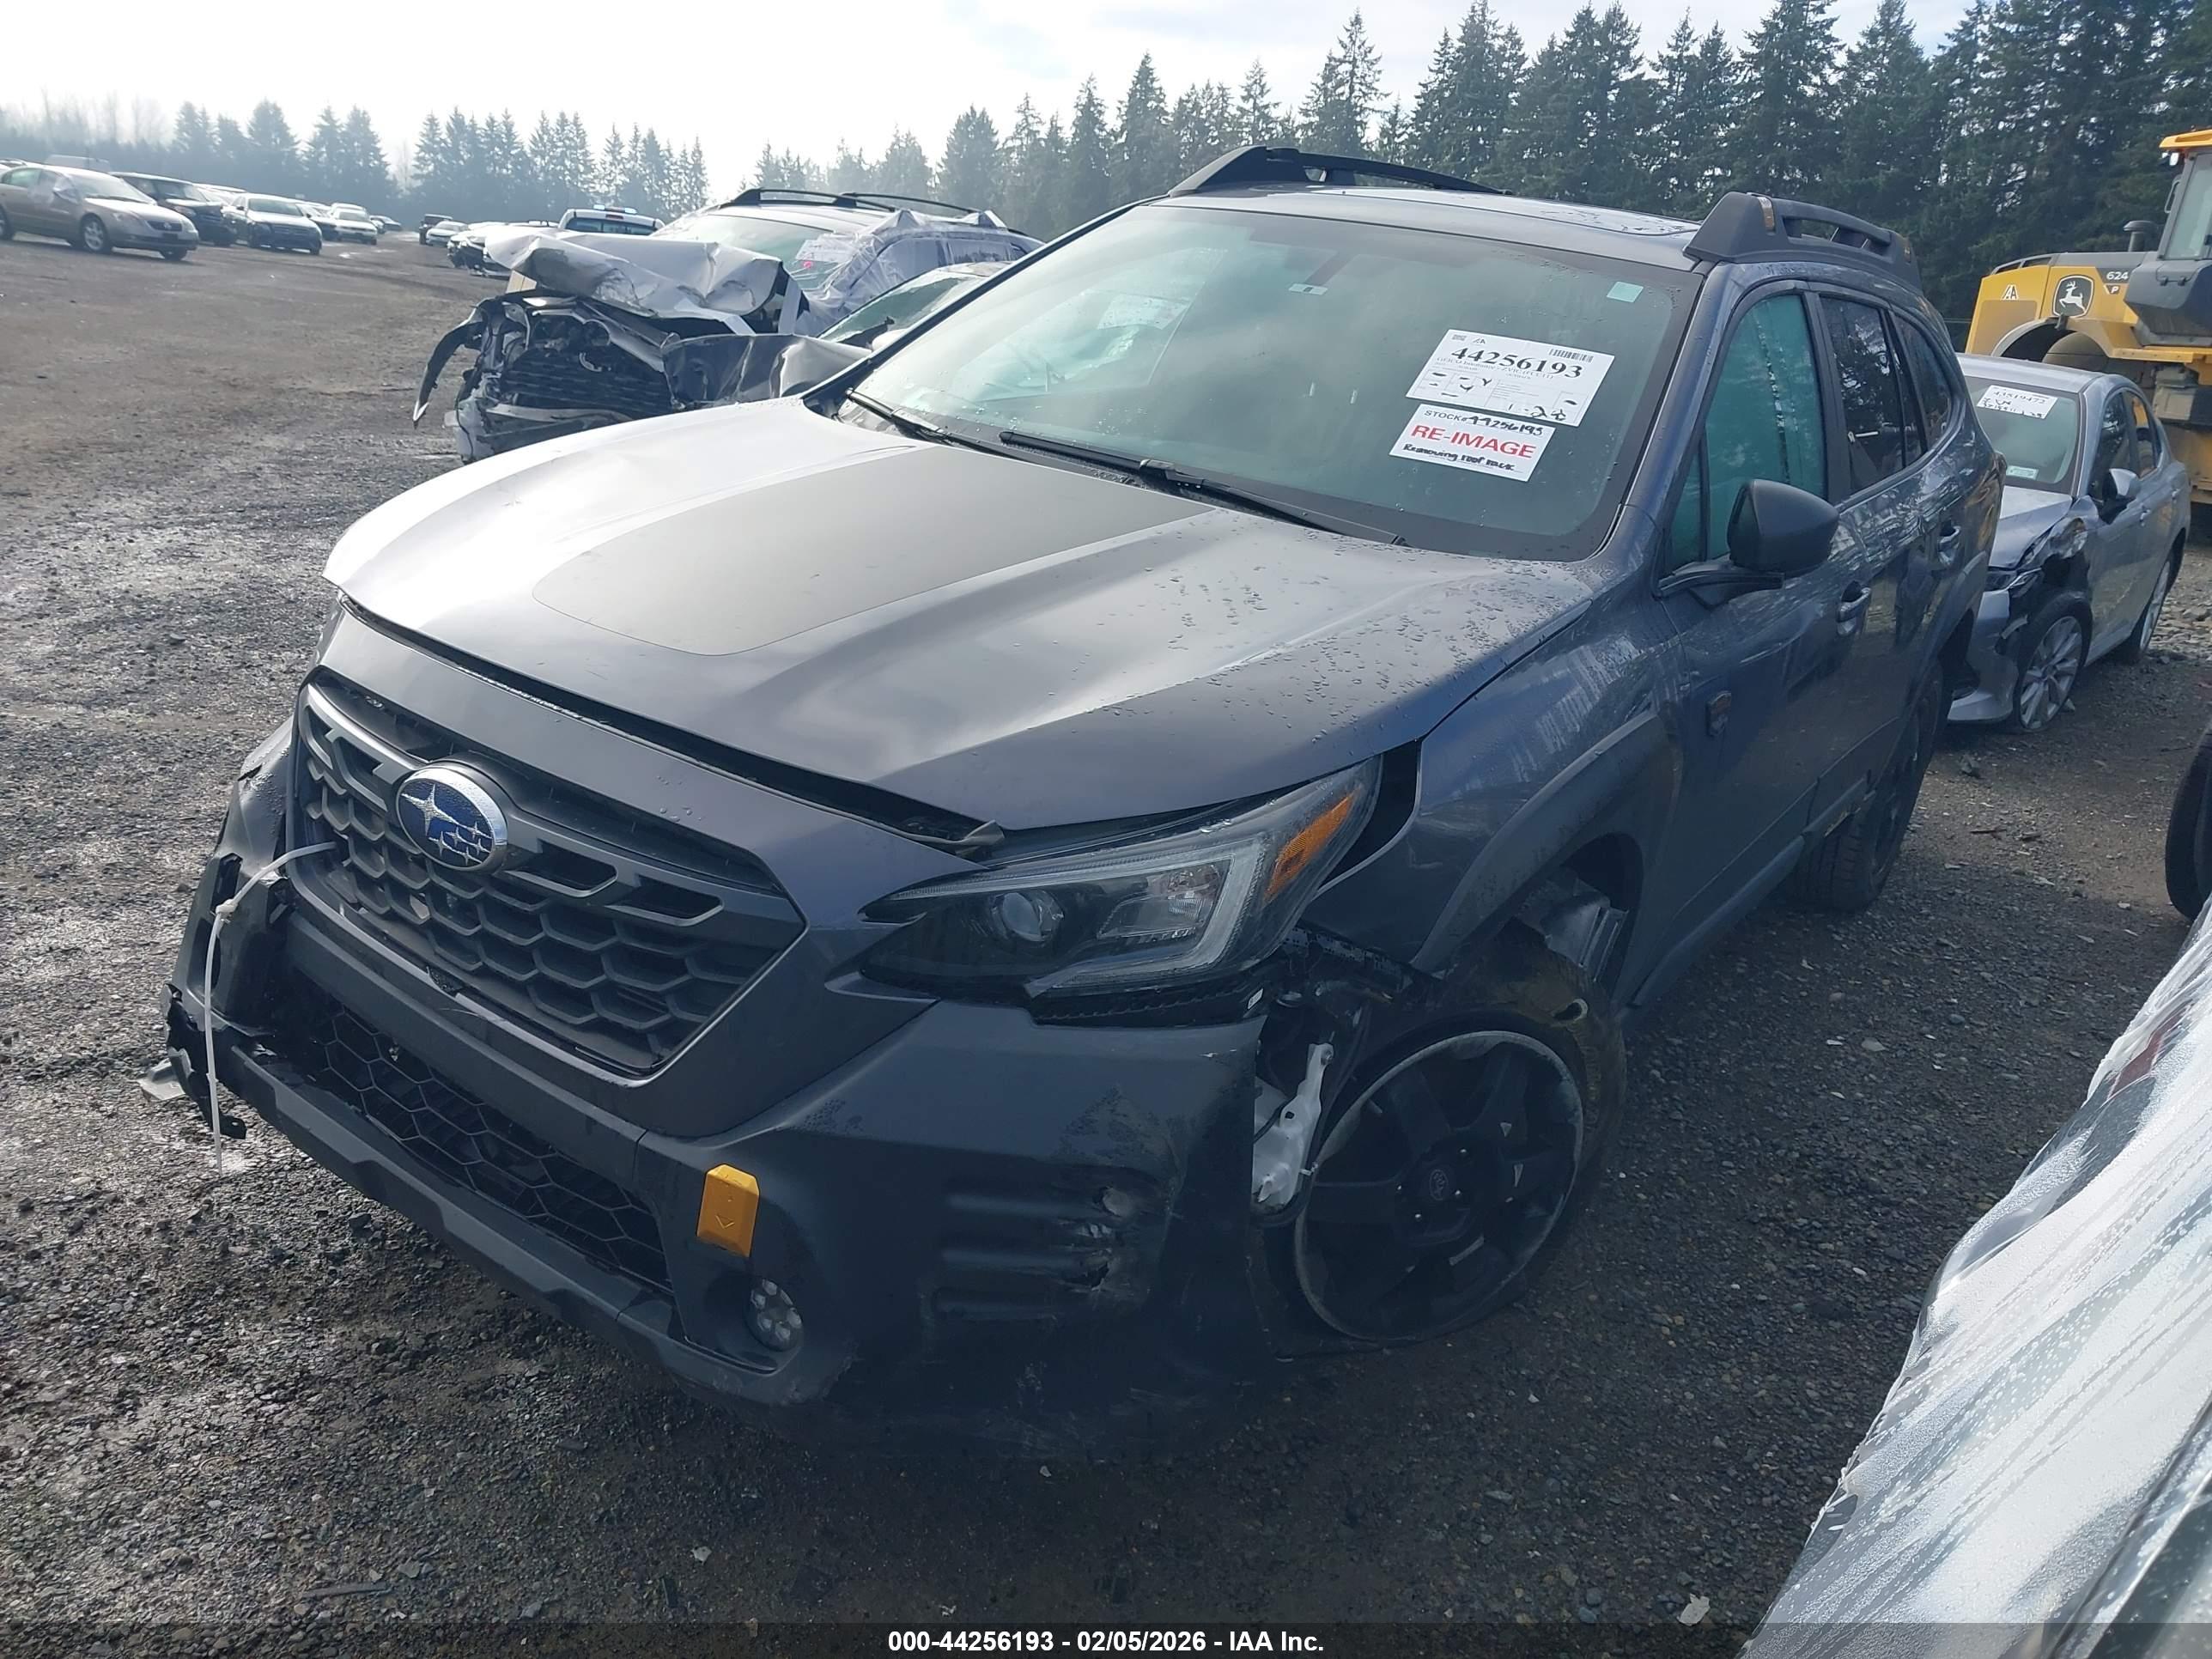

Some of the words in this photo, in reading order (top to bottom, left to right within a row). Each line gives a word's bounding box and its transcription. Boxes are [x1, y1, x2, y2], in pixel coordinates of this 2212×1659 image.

[2106, 270, 2129, 281] 624
[2110, 285, 2118, 294] P
[1451, 347, 1583, 379] 44256193
[1411, 424, 1536, 459] RE-IMAGE
[1461, 454, 1486, 464] roof
